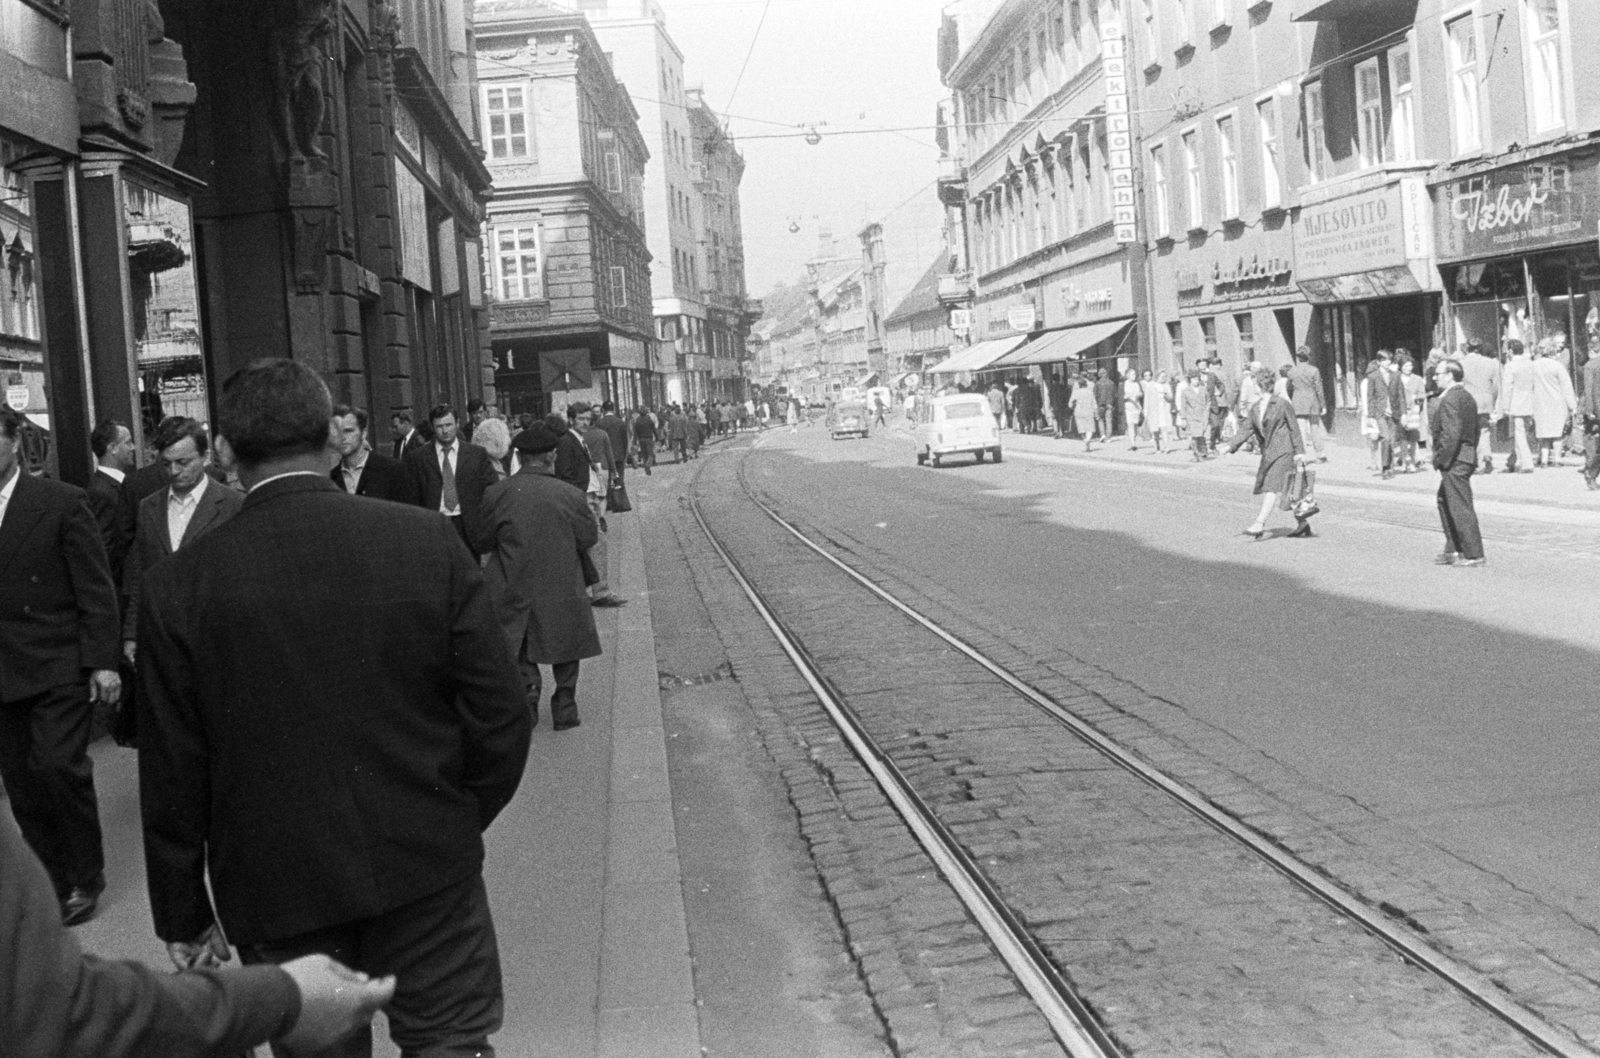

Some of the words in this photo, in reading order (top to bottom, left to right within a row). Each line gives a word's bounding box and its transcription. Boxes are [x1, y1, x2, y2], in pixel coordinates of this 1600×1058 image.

[1103, 25, 1135, 240] elektrotehna
[1409, 183, 1420, 253] OPTICAR
[1451, 182, 1548, 233] Izbor
[1305, 243, 1352, 259] POSLOVNICA
[1354, 235, 1390, 251] ZAGREB
